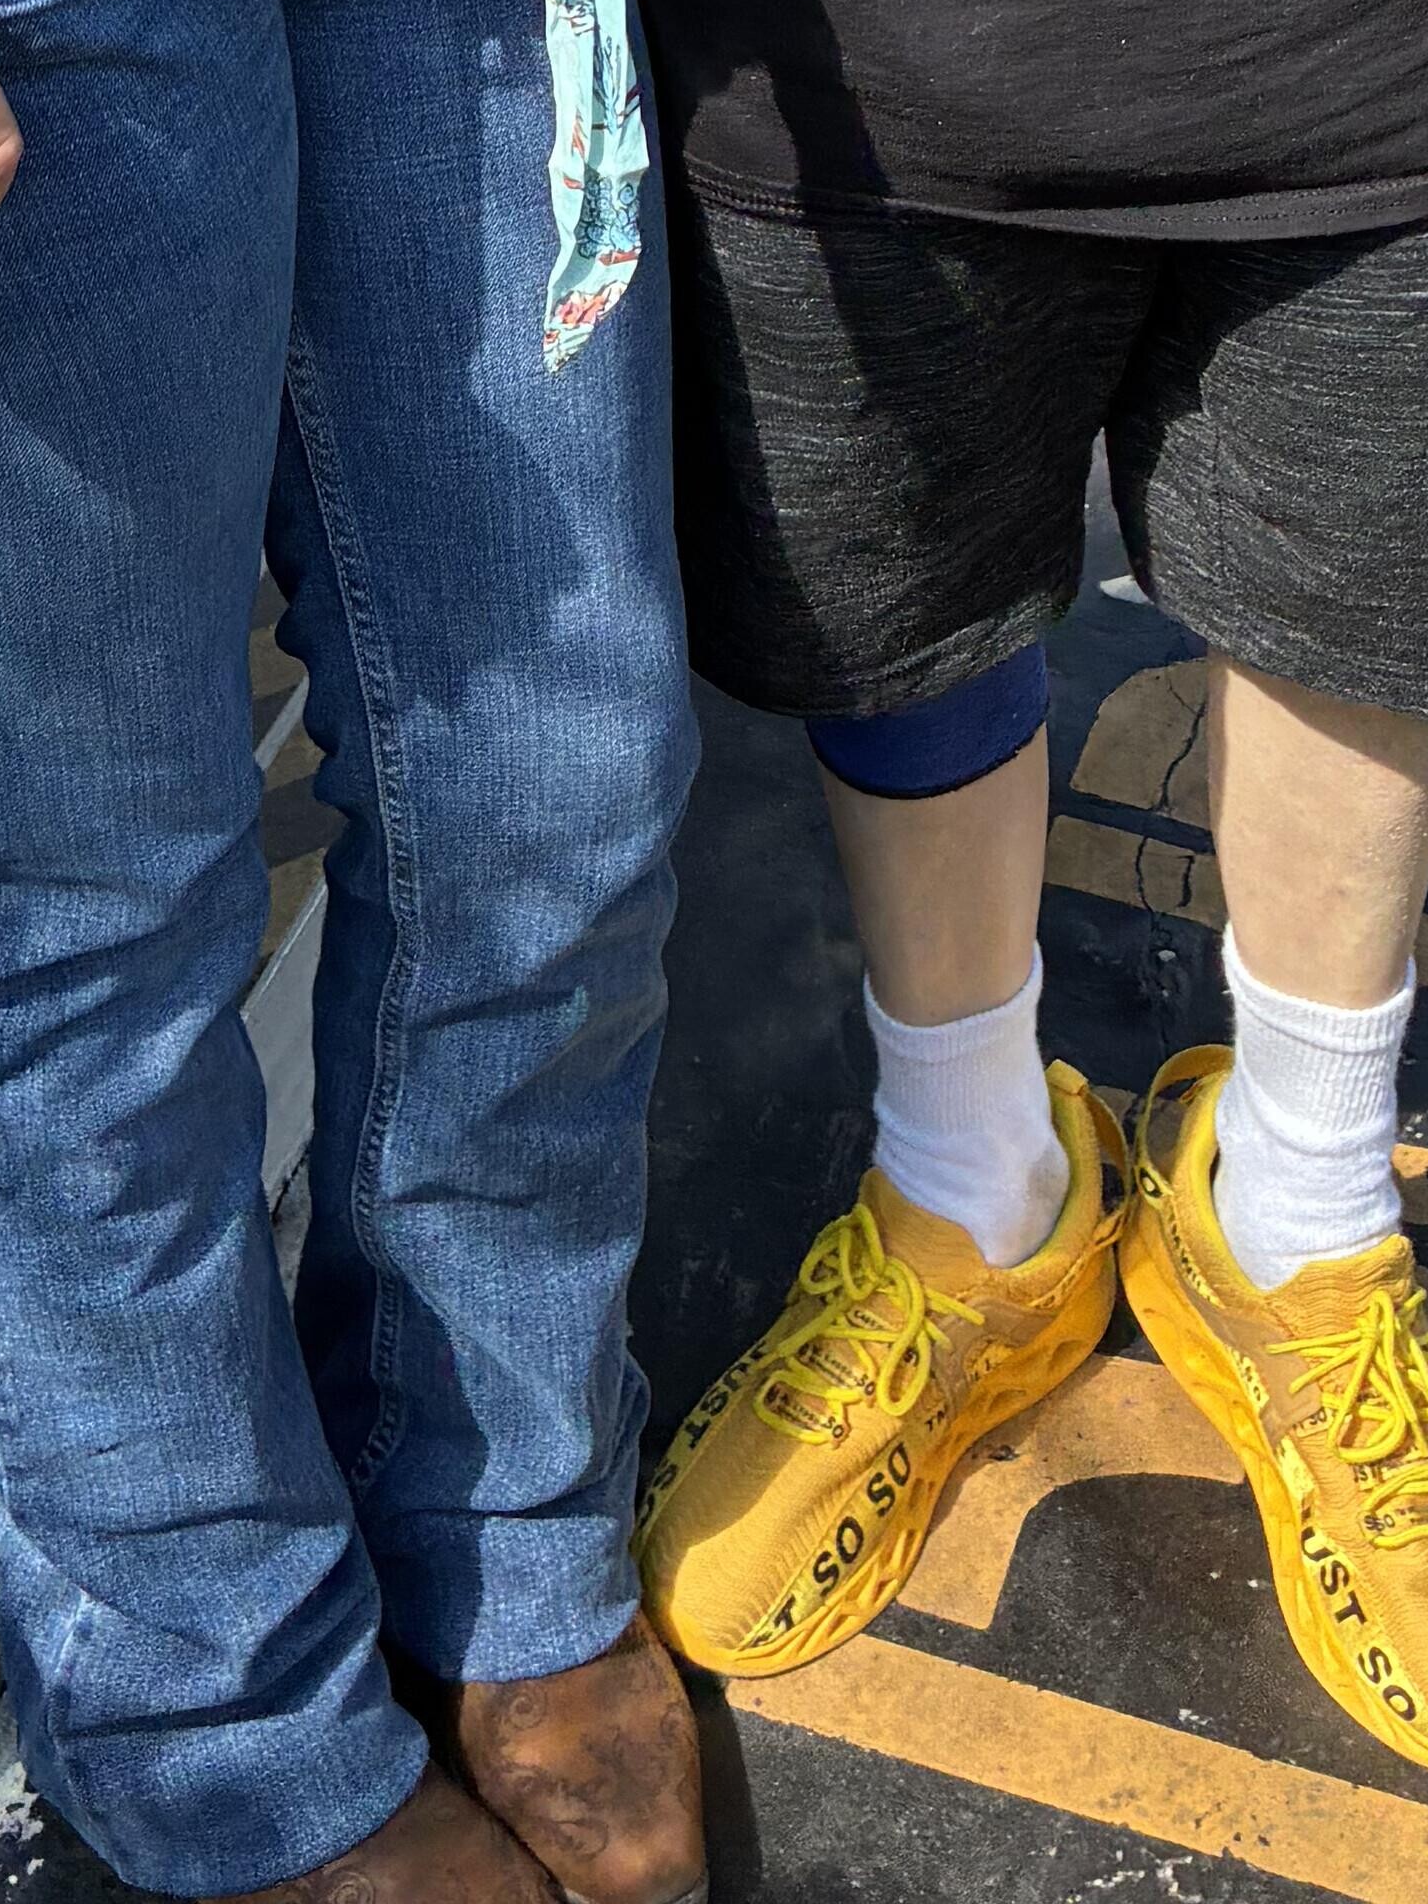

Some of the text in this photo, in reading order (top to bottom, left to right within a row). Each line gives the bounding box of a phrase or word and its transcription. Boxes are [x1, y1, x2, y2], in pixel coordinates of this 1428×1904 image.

[812, 1442, 912, 1598] SO SO
[1357, 1645, 1417, 1722] SO
